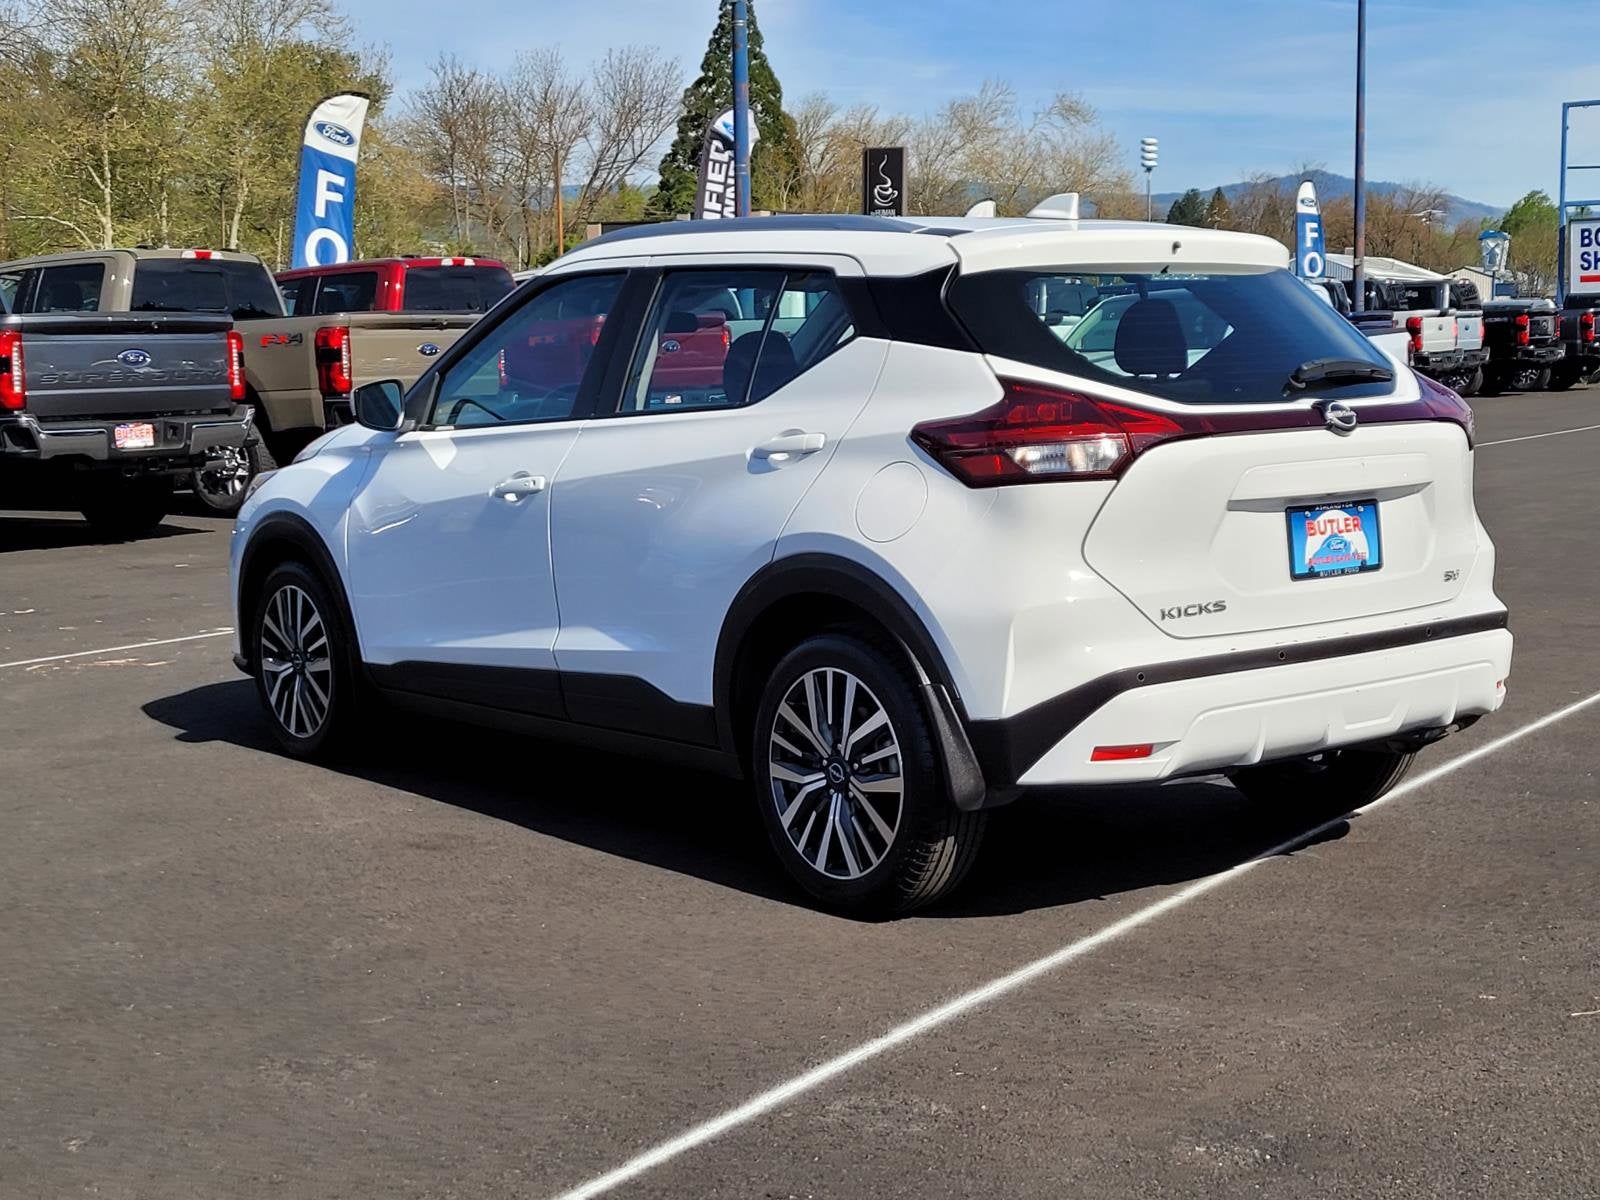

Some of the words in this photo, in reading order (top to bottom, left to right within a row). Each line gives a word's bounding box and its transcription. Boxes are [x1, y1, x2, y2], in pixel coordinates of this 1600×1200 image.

[322, 124, 349, 146] Ford
[260, 333, 303, 348] FX4
[40, 370, 145, 384] SUPER
[1306, 516, 1362, 537] BUTLER
[1160, 600, 1227, 621] KICKS
